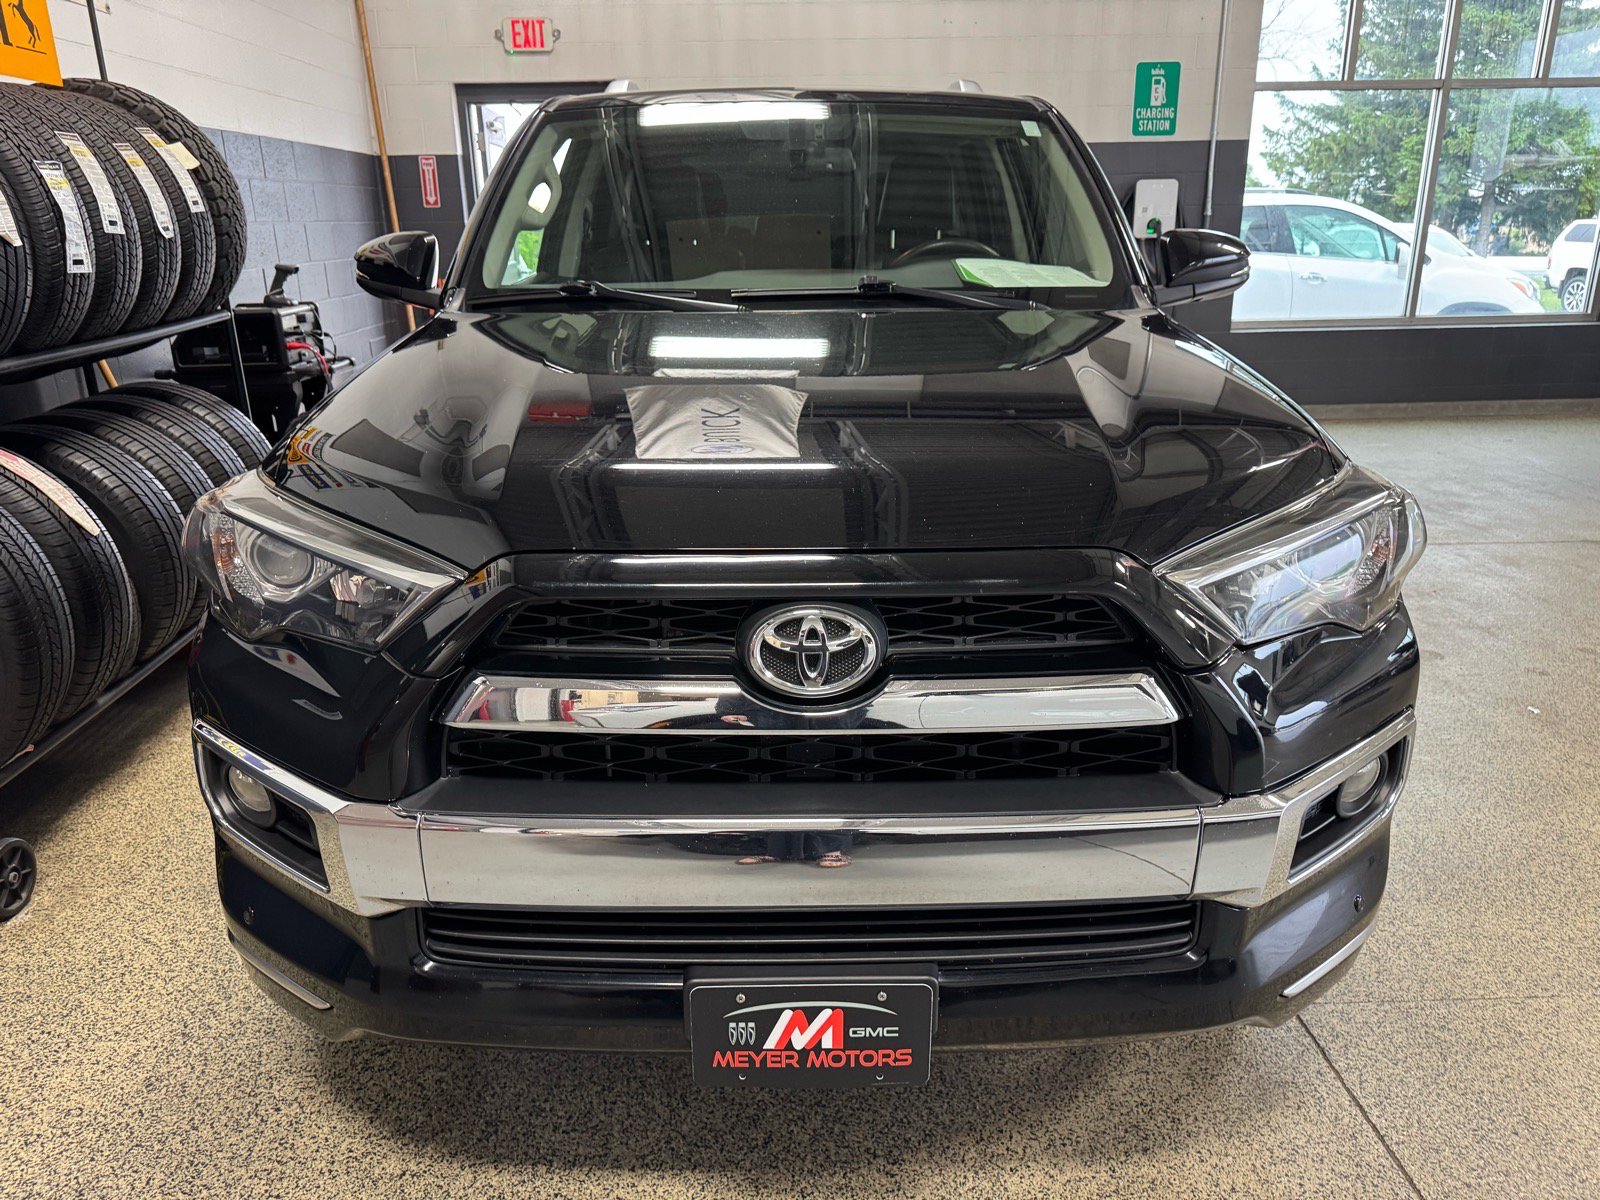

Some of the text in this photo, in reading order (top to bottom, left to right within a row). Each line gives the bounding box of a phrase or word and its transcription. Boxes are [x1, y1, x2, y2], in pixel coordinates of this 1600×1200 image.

[510, 19, 545, 49] EXIT
[1136, 107, 1175, 119] CHARGING
[1138, 120, 1170, 131] STATION
[849, 1027, 899, 1037] GMC
[712, 1049, 913, 1068] MEYER MOTORS
